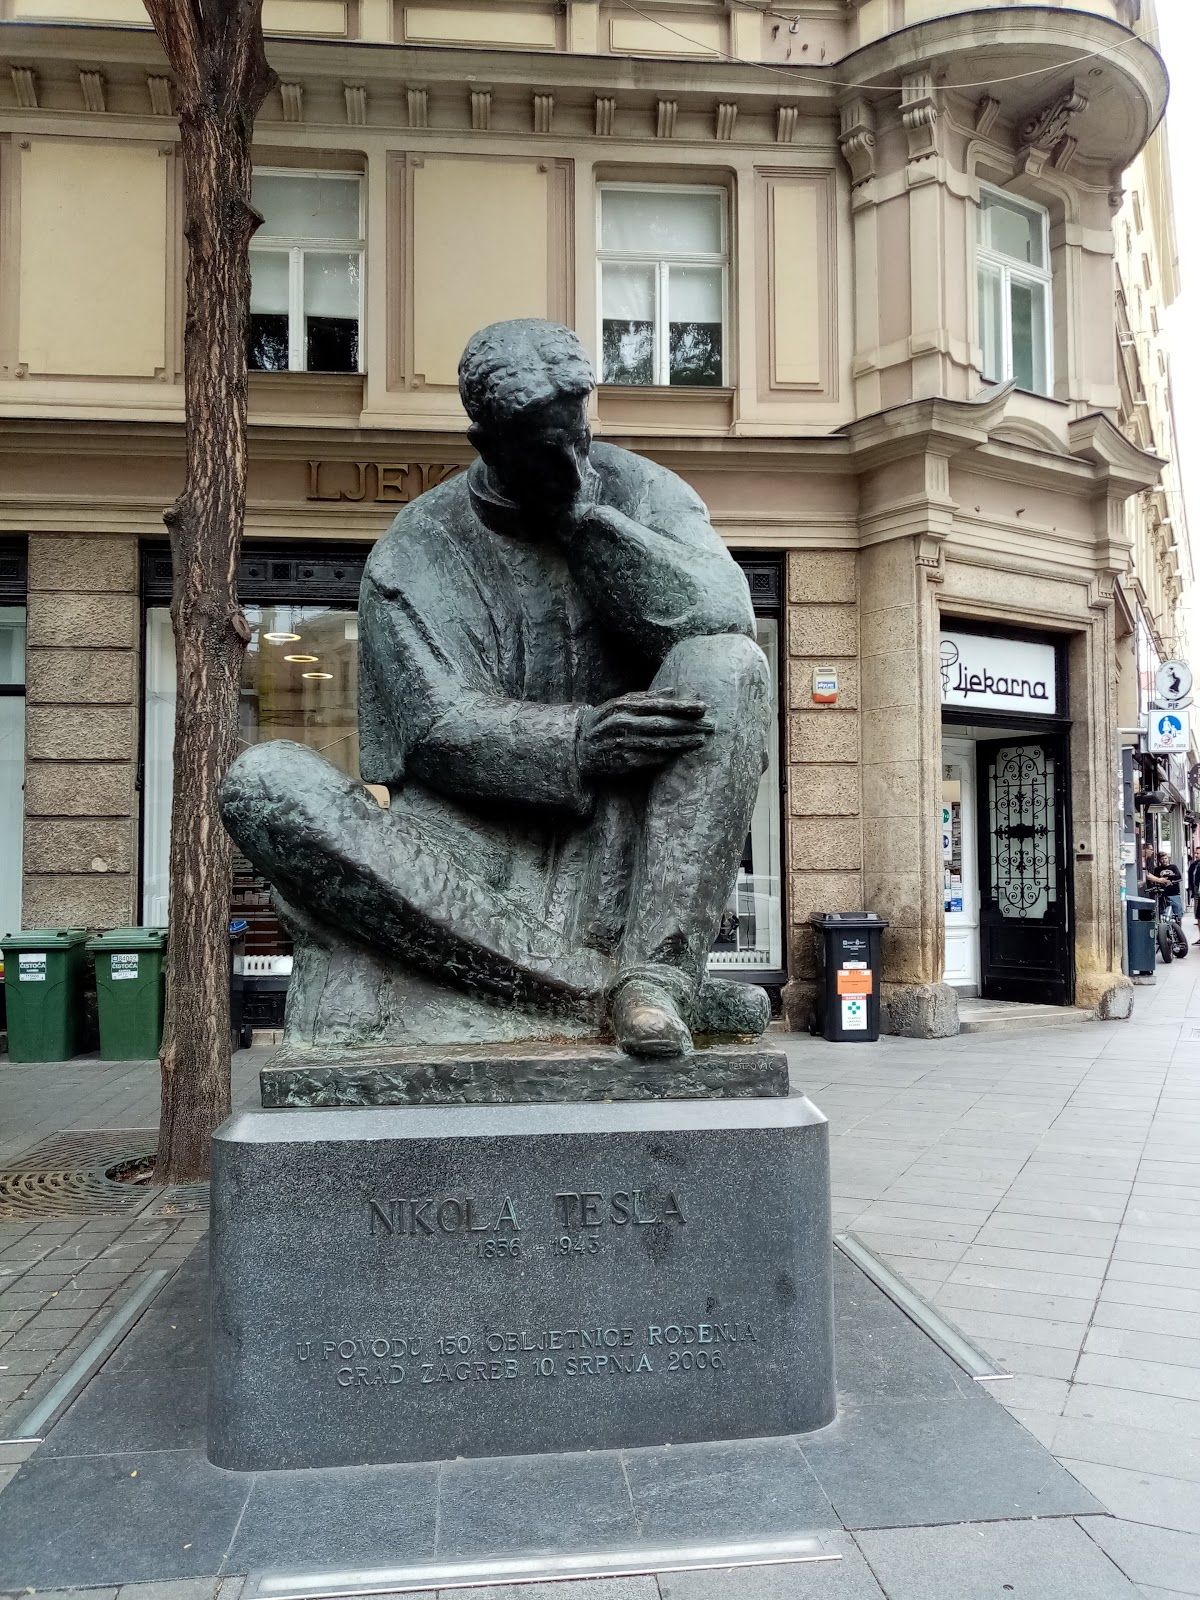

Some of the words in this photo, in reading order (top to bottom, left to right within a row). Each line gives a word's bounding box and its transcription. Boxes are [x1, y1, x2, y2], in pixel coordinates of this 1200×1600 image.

[369, 1196, 521, 1236] NIKOLA
[555, 1189, 688, 1228] TESLA
[296, 1341, 312, 1361] U
[321, 1337, 423, 1361] POVODU
[437, 1335, 477, 1356] 150.
[486, 1327, 634, 1352] OBLJETNICE
[337, 1364, 406, 1387] GRAD
[420, 1359, 519, 1384] ZAGREB
[565, 1353, 654, 1376] SRPNJA
